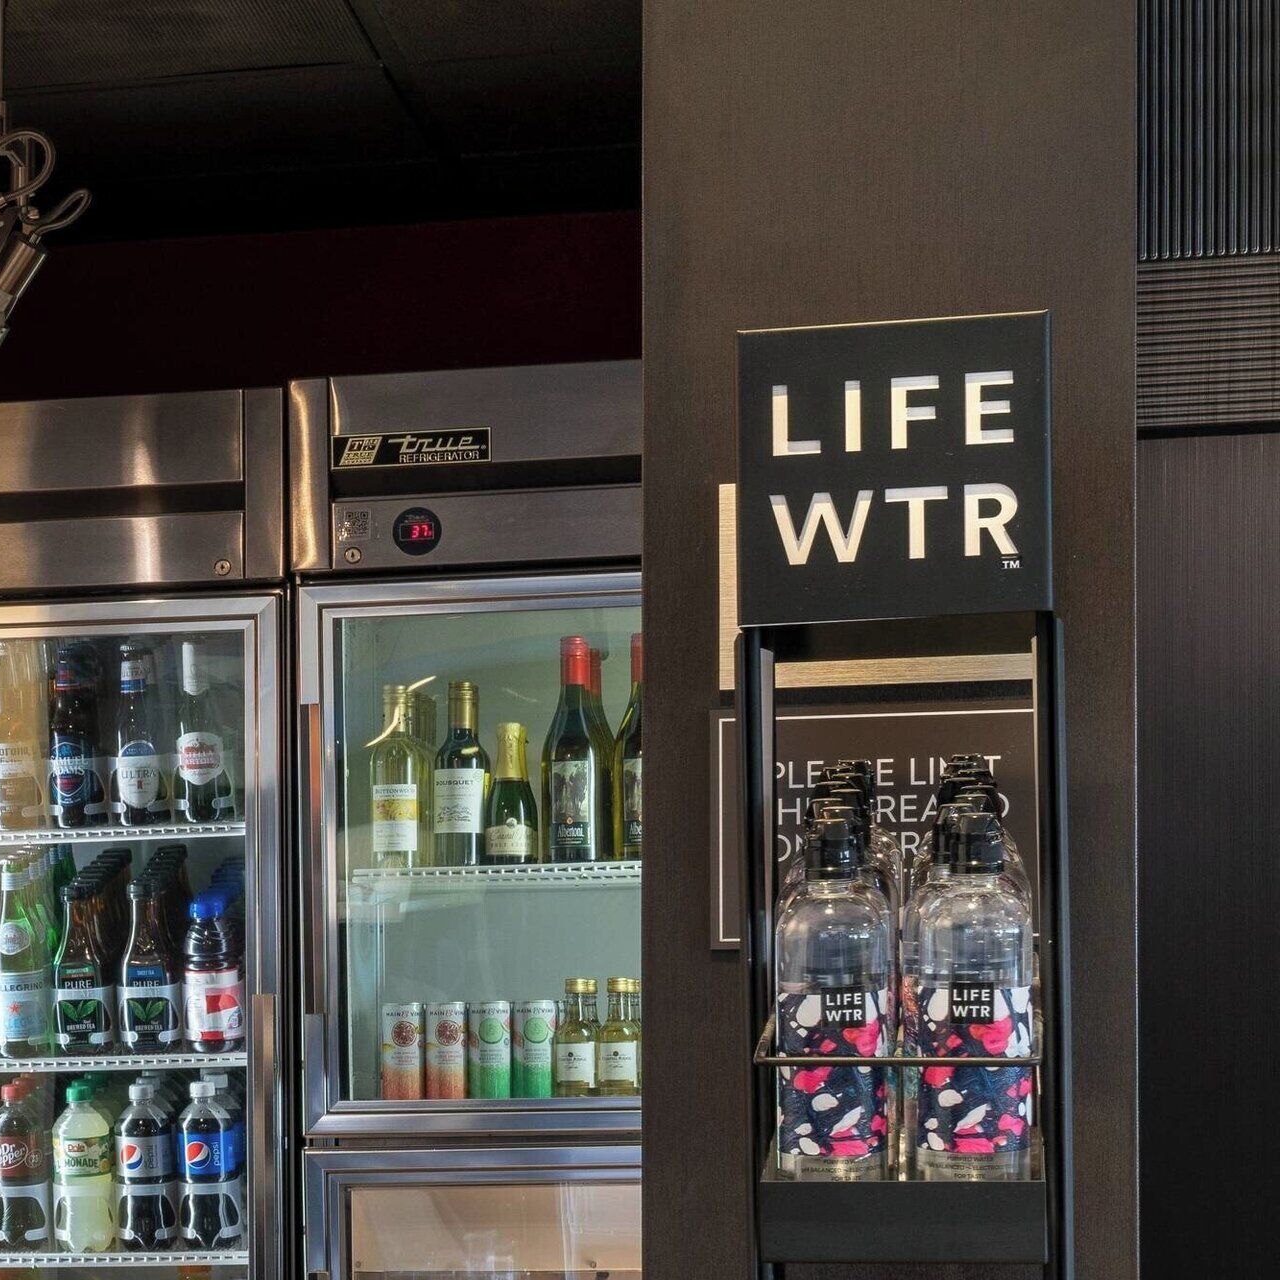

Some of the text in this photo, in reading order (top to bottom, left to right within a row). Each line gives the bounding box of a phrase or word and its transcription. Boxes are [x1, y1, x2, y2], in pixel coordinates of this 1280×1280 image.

[772, 370, 1015, 456] LIFE
[388, 435, 480, 454] true
[399, 450, 480, 463] REFRIGERATOR
[769, 482, 1019, 566] WTR
[121, 768, 157, 779] ULTRA
[777, 755, 1002, 789] PLEE LIT
[64, 980, 93, 990] PURE
[132, 980, 160, 988] PURE
[825, 993, 863, 1007] LIFE
[952, 989, 991, 1002] LIFE
[825, 1009, 864, 1022] WTR
[952, 1005, 991, 1018] WTR
[2, 1143, 16, 1152] Dr
[67, 1143, 85, 1153] Dole
[212, 1142, 221, 1166] pepsi
